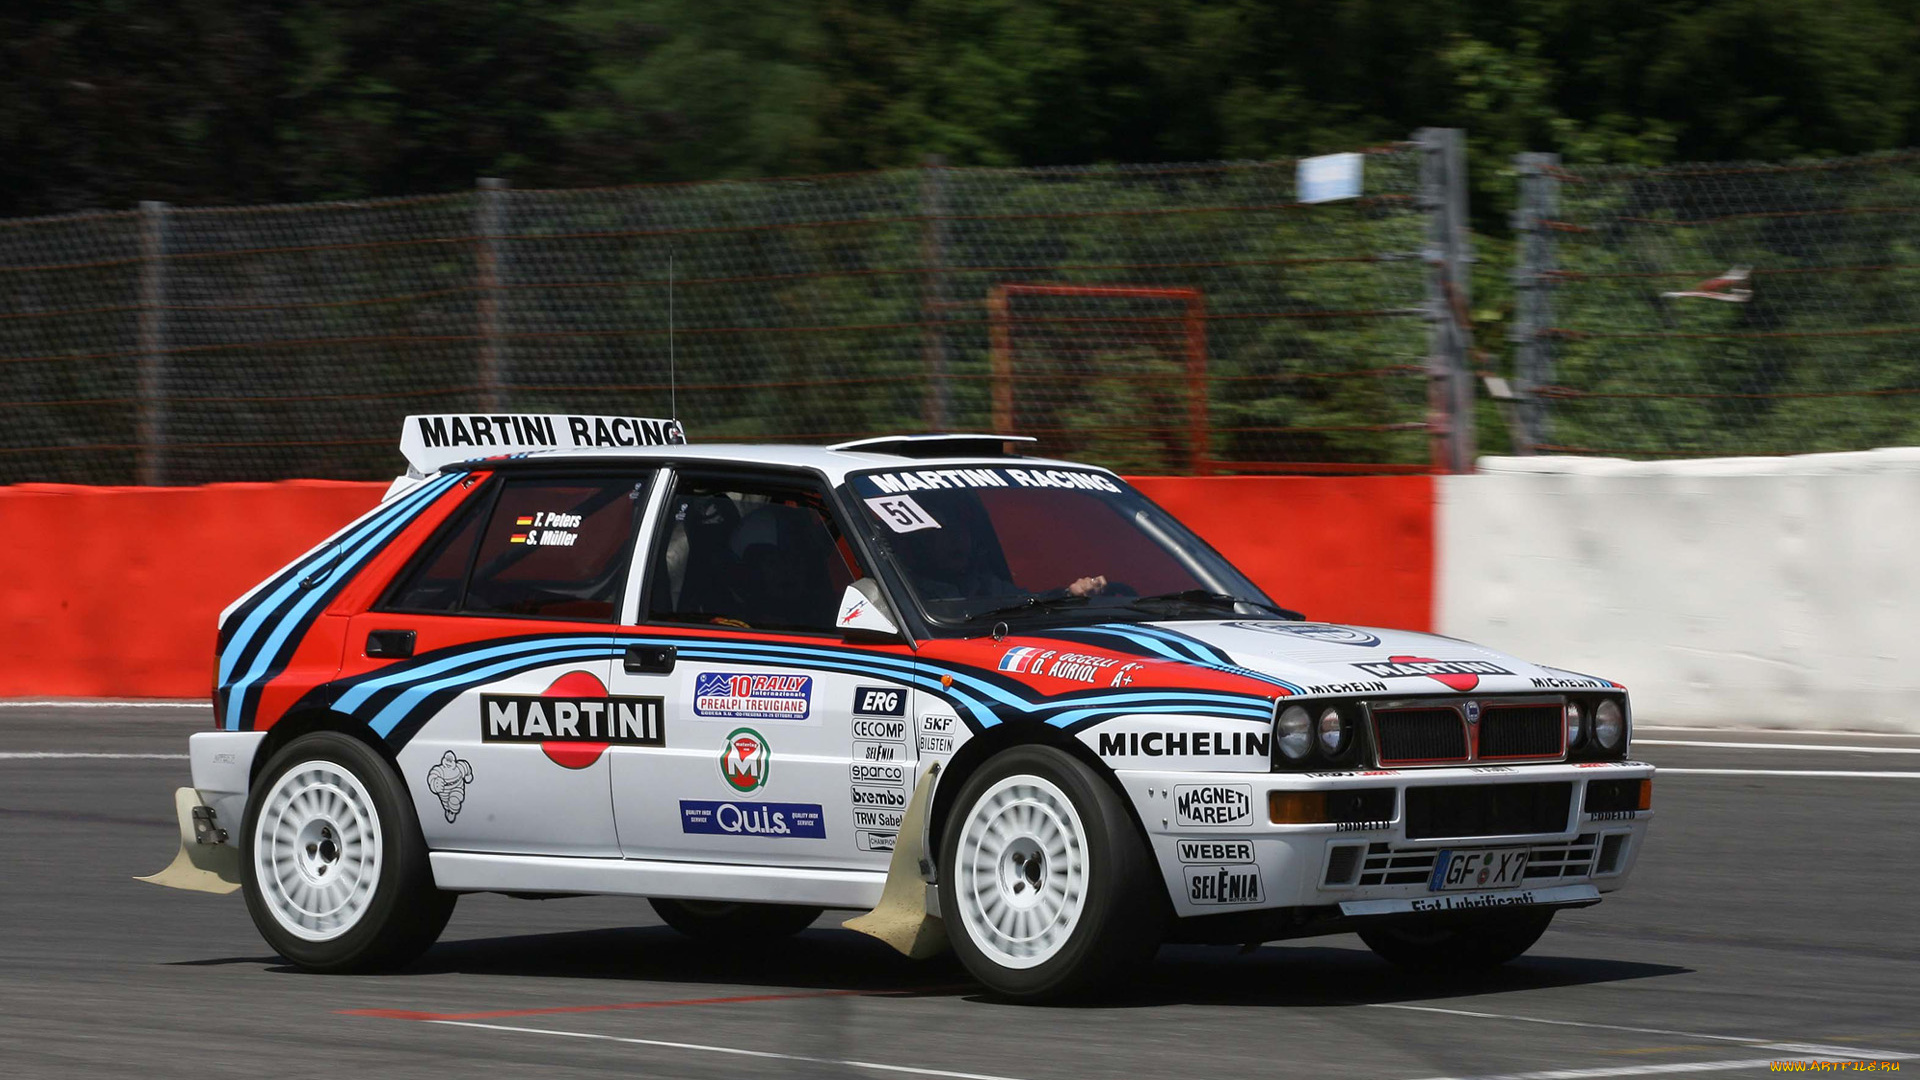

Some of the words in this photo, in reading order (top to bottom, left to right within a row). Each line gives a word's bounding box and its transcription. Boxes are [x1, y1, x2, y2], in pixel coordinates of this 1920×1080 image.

[418, 417, 557, 448] MARTINI
[567, 417, 685, 446] RACING
[868, 468, 1008, 493] MARTINI
[1007, 469, 1122, 493] RACING
[534, 512, 544, 527] T.
[544, 512, 582, 528] Peters
[879, 500, 925, 526] 51
[526, 530, 537, 546] S.
[540, 530, 578, 546] Müller
[1030, 658, 1043, 675] D.
[1048, 661, 1098, 683] AURIOL
[1110, 671, 1133, 688] A+
[1361, 661, 1508, 677] MARTINI
[753, 676, 808, 693] RALLY
[1307, 681, 1388, 695] MICHELIN
[1529, 678, 1598, 688] MICHELIN
[701, 698, 741, 711] PREALPI
[746, 699, 804, 713] TREVIGIANE
[862, 691, 898, 712] ERG
[489, 701, 657, 740] MARTINI
[924, 717, 953, 731] SKF
[854, 722, 904, 738] CECOMP
[920, 736, 952, 752] BILSTEIN
[1099, 733, 1271, 756] MICHELIN
[852, 765, 902, 780] sparco
[852, 787, 905, 806] brembo
[1178, 787, 1250, 815] MAGNETI
[855, 811, 877, 826] TRW
[1178, 806, 1250, 824] MARELLI
[1182, 844, 1250, 859] WEBER
[1446, 854, 1480, 885] GF
[1494, 852, 1526, 882] X7
[1192, 867, 1258, 903] SELÈNIA
